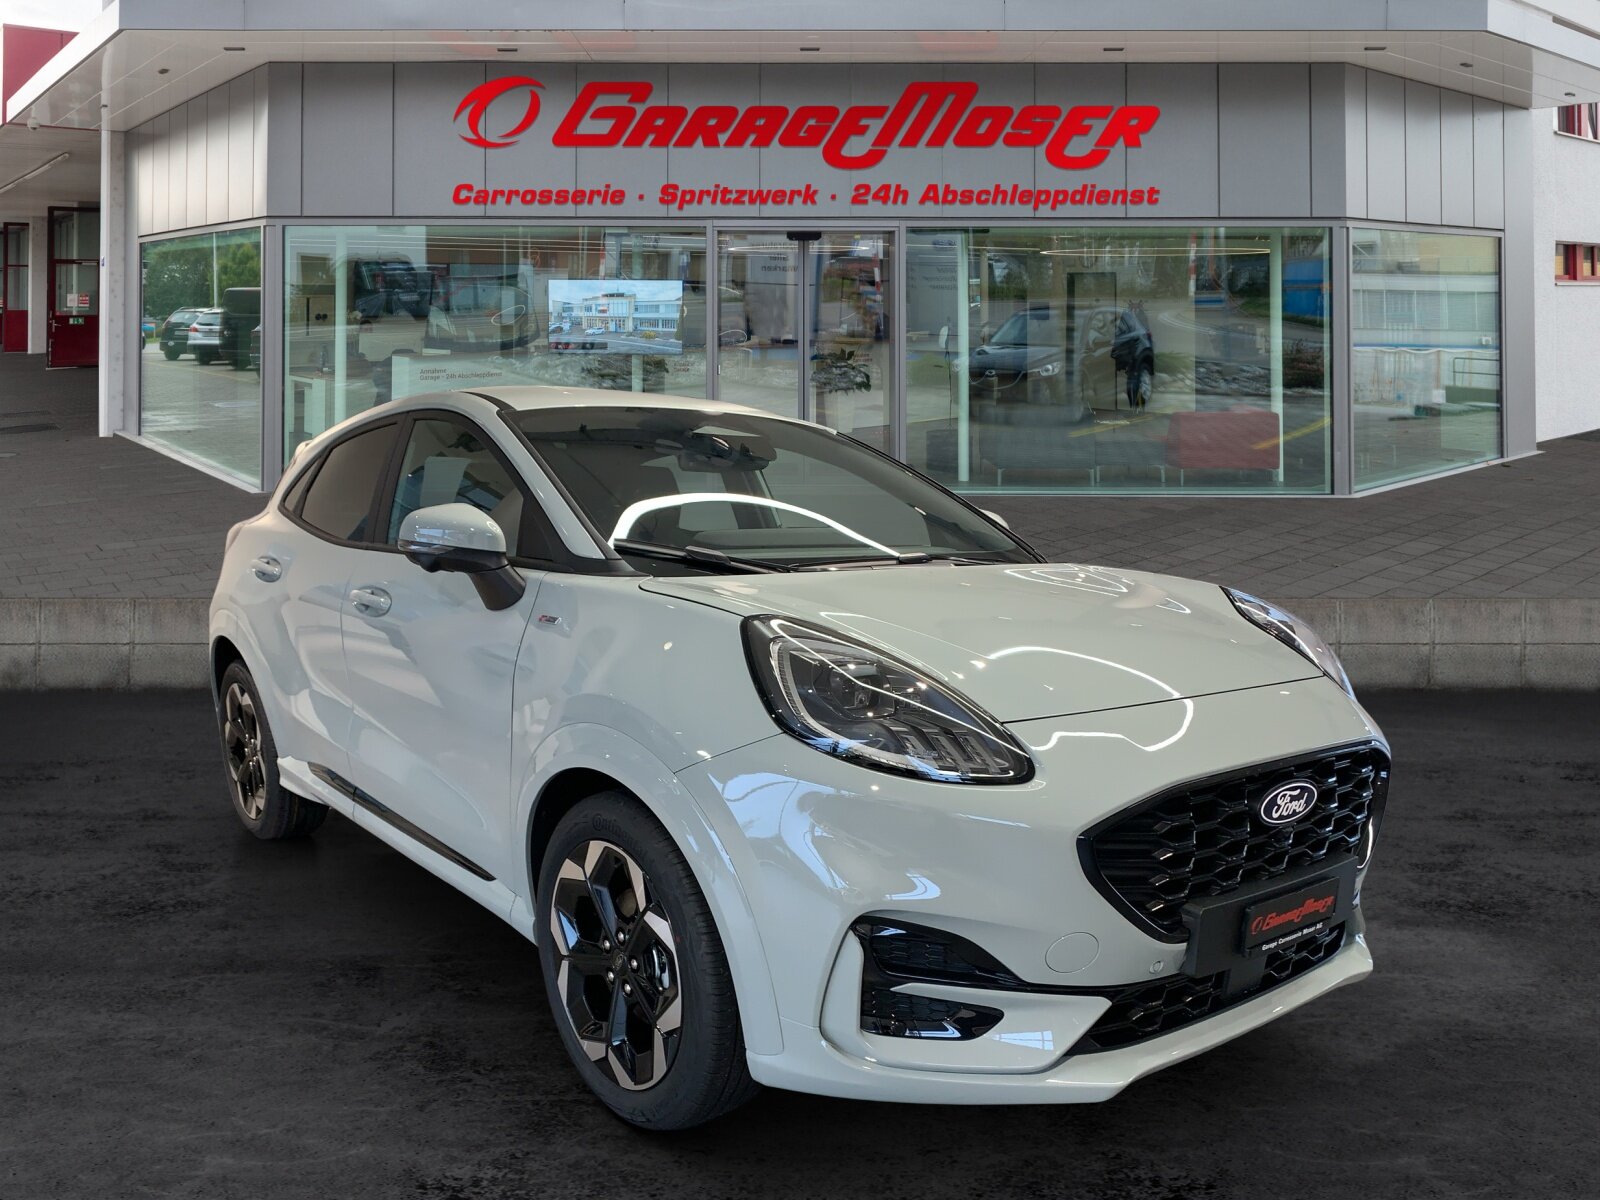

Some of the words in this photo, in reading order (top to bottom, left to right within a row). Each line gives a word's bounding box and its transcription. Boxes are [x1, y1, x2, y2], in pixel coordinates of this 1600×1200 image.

[452, 183, 626, 206] Carrosserie
[659, 183, 818, 210] Spritzwerk
[851, 184, 909, 206] 24h
[919, 183, 1161, 210] Abschleppdienst
[1272, 789, 1308, 818] Ford
